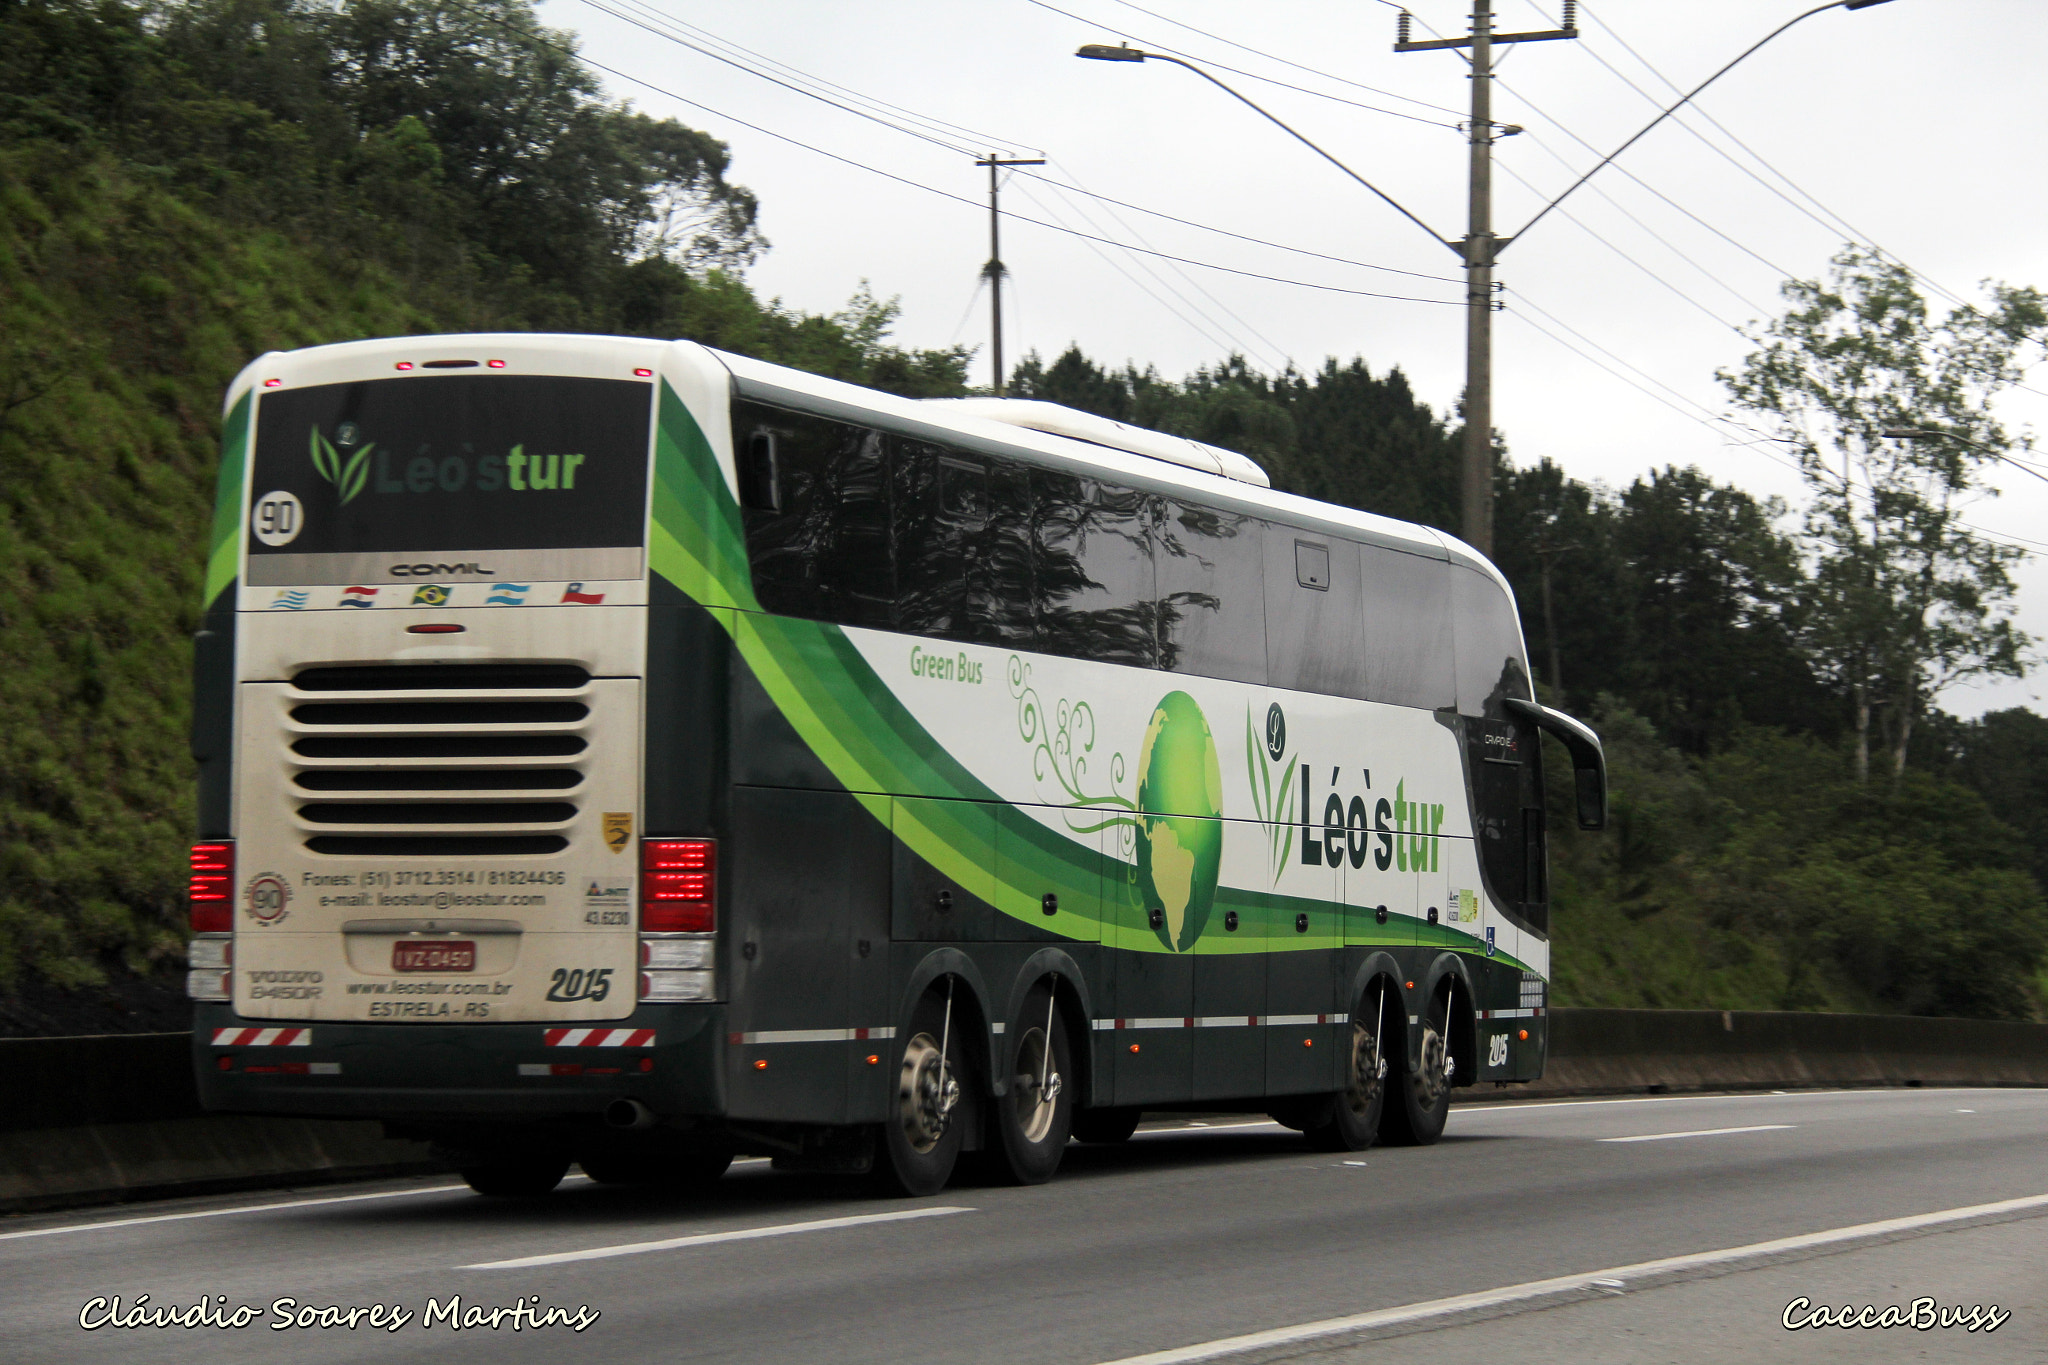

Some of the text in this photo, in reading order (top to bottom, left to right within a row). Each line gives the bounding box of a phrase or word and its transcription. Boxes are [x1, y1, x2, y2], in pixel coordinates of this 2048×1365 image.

[260, 500, 294, 534] 90
[389, 562, 495, 577] COMIL
[910, 645, 983, 685] Green Bus
[302, 871, 356, 887] Fones:
[360, 871, 391, 889] (51)
[394, 871, 475, 886] 3712.3514
[478, 871, 487, 887] /
[487, 871, 566, 886] 81824436
[253, 889, 284, 909] 90
[319, 892, 546, 910] e-mail: leostur@leostur.com
[247, 970, 324, 983] VOLVO
[545, 967, 615, 1002] 2015
[250, 986, 323, 1000] B450R
[346, 980, 513, 995] www.leostur.com.br
[368, 1002, 449, 1017] ESTRELA
[464, 1002, 490, 1017] RS
[1488, 1033, 1509, 1067] 2015
